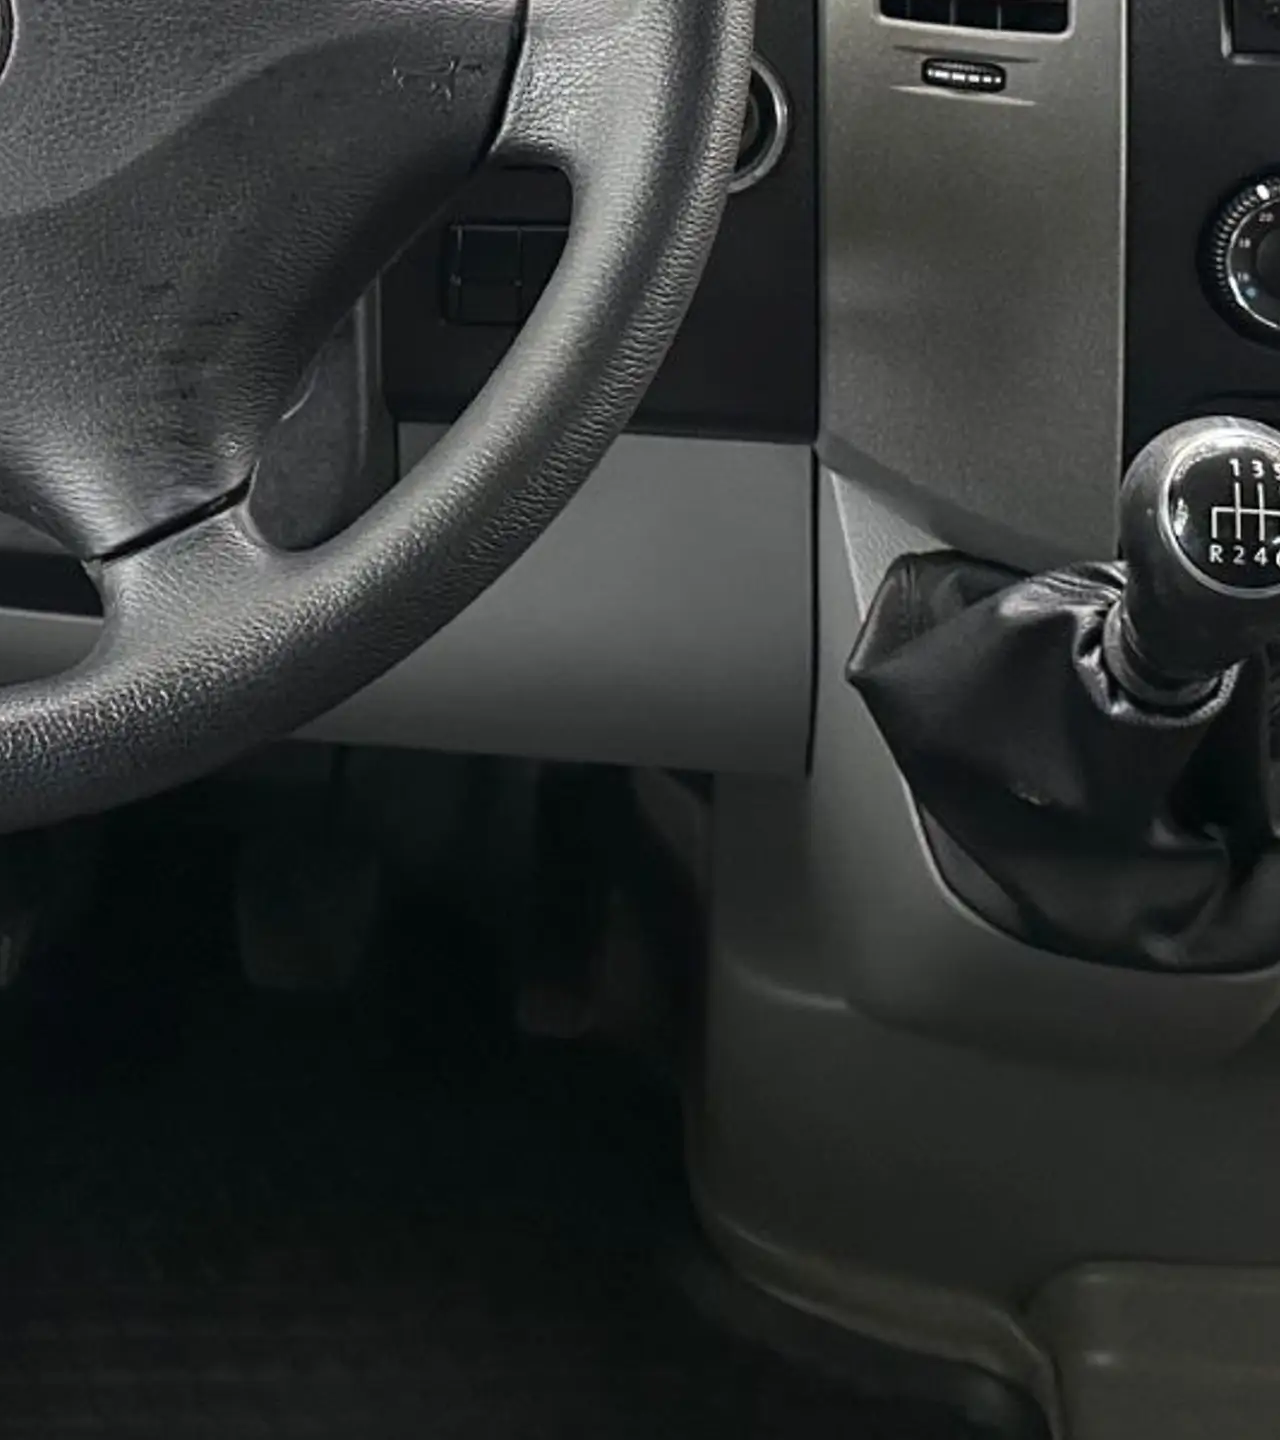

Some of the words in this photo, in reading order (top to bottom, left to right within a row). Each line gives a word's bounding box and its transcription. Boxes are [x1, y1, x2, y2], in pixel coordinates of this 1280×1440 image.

[1229, 458, 1240, 477] 1
[1252, 460, 1264, 478] 3
[1209, 545, 1224, 563] R
[1233, 547, 1246, 565] 2
[1254, 547, 1268, 565] 4
